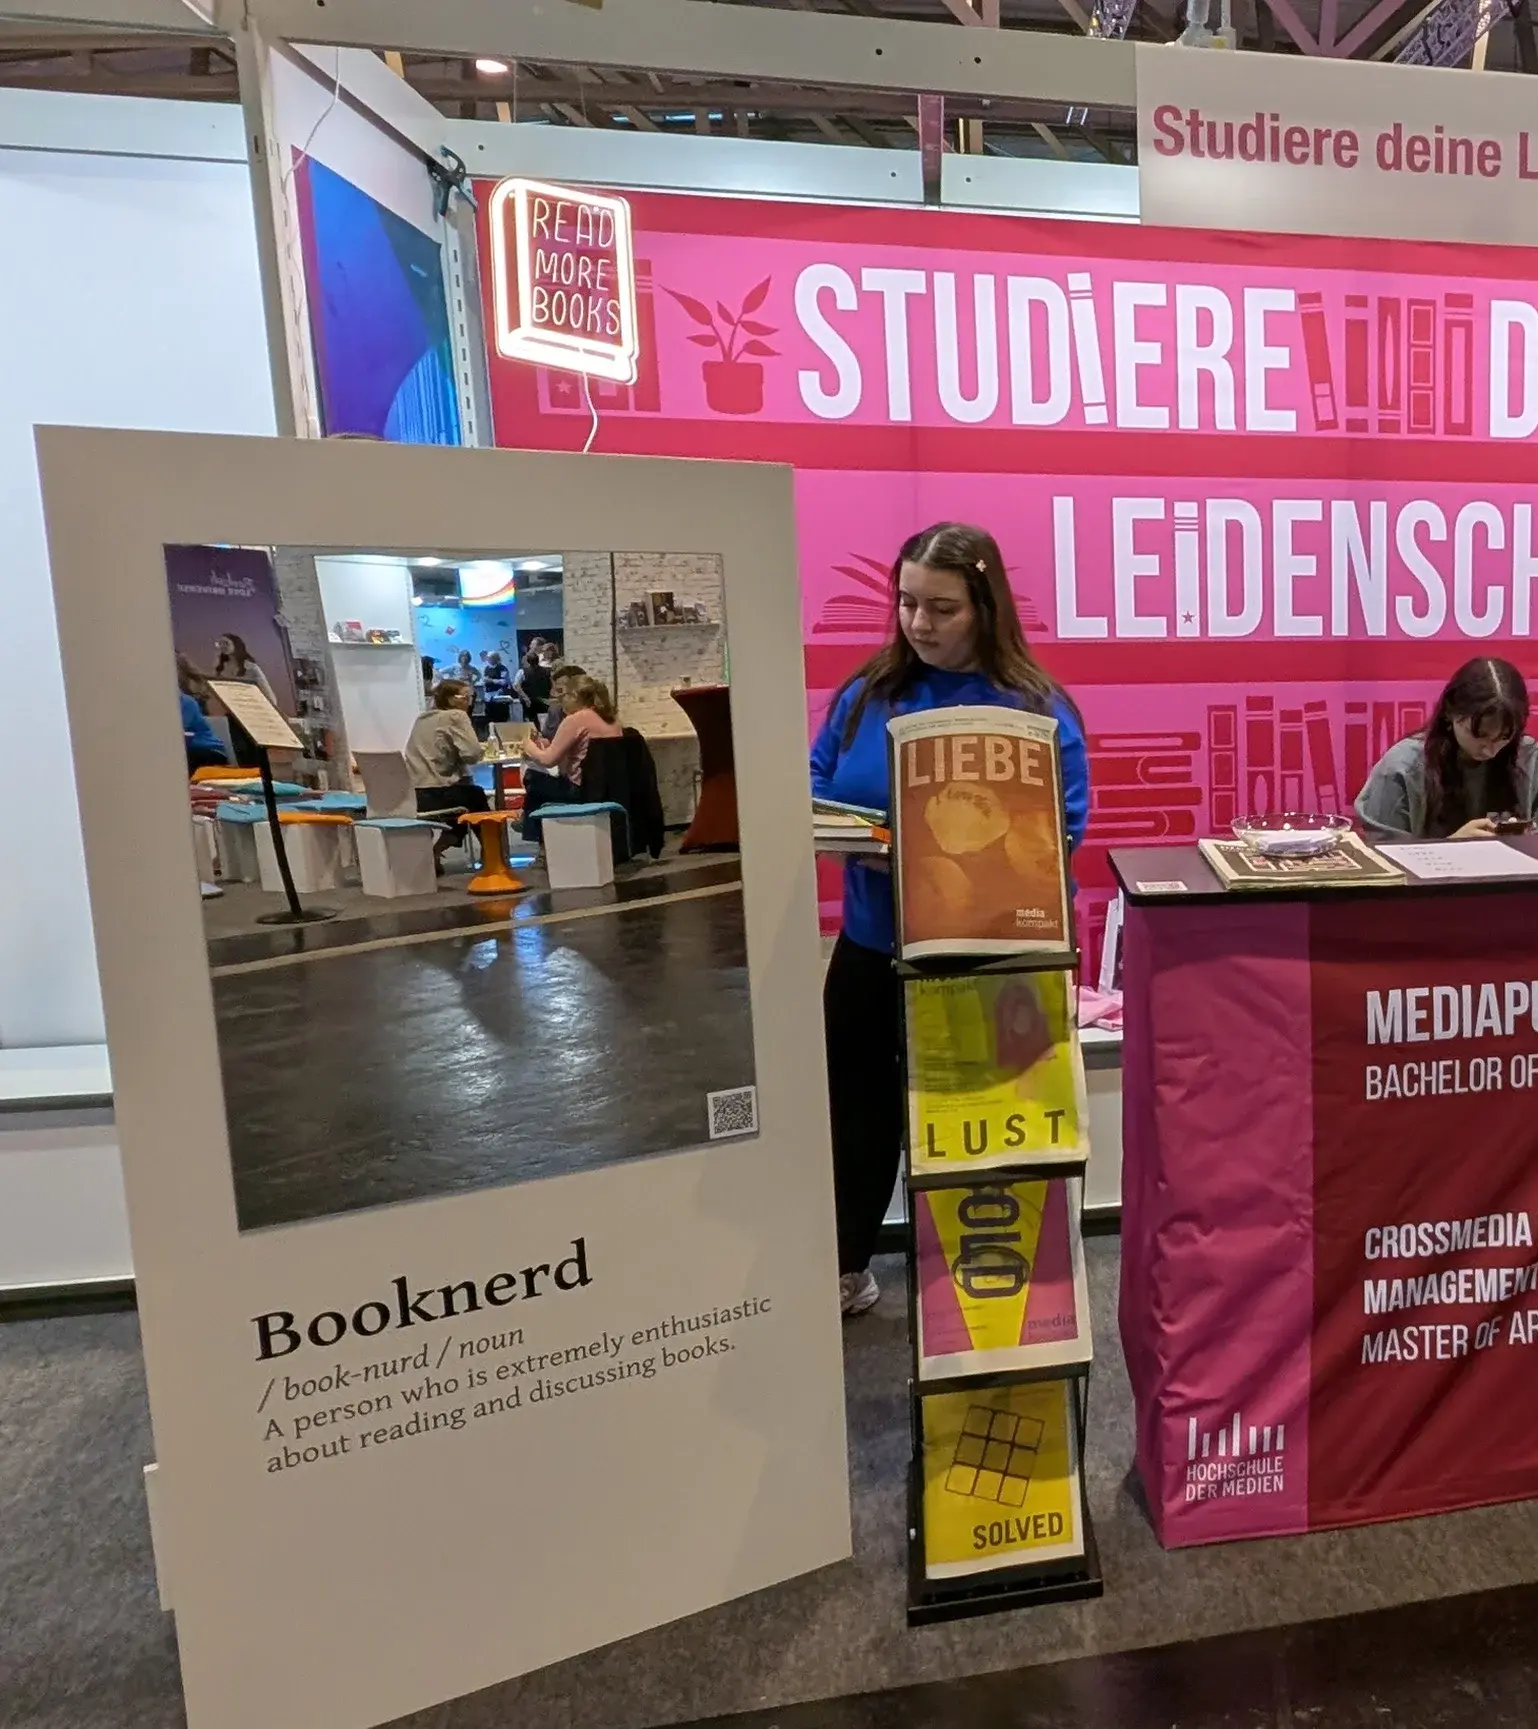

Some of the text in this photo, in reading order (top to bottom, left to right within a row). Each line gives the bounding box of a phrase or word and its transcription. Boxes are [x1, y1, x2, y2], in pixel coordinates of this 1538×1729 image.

[1153, 104, 1359, 169] Studiere
[1376, 121, 1502, 178] deine
[532, 198, 615, 248] READ
[535, 248, 612, 292] MORE
[532, 286, 621, 335] BOOKS
[907, 735, 1045, 788] LIEBE
[1366, 1055, 1502, 1101] BACHELOR
[926, 1109, 1066, 1159] LUST
[957, 1186, 1024, 1299] OLD
[1364, 1211, 1533, 1261] CROSSMEDIA
[250, 1237, 594, 1362] Booknerd
[283, 1342, 430, 1402] book-nurd
[459, 1327, 525, 1359] noun
[1361, 1324, 1469, 1365] MASTER
[1474, 1316, 1503, 1351] OF
[263, 1296, 773, 1442] A person who is extremely enthusiastic
[266, 1335, 737, 1474] about reading and discussing books.
[1185, 1475, 1285, 1502] DER MEDIEN
[1186, 1455, 1285, 1482] HOCHSCHULE
[972, 1511, 1064, 1550] SOLVED
